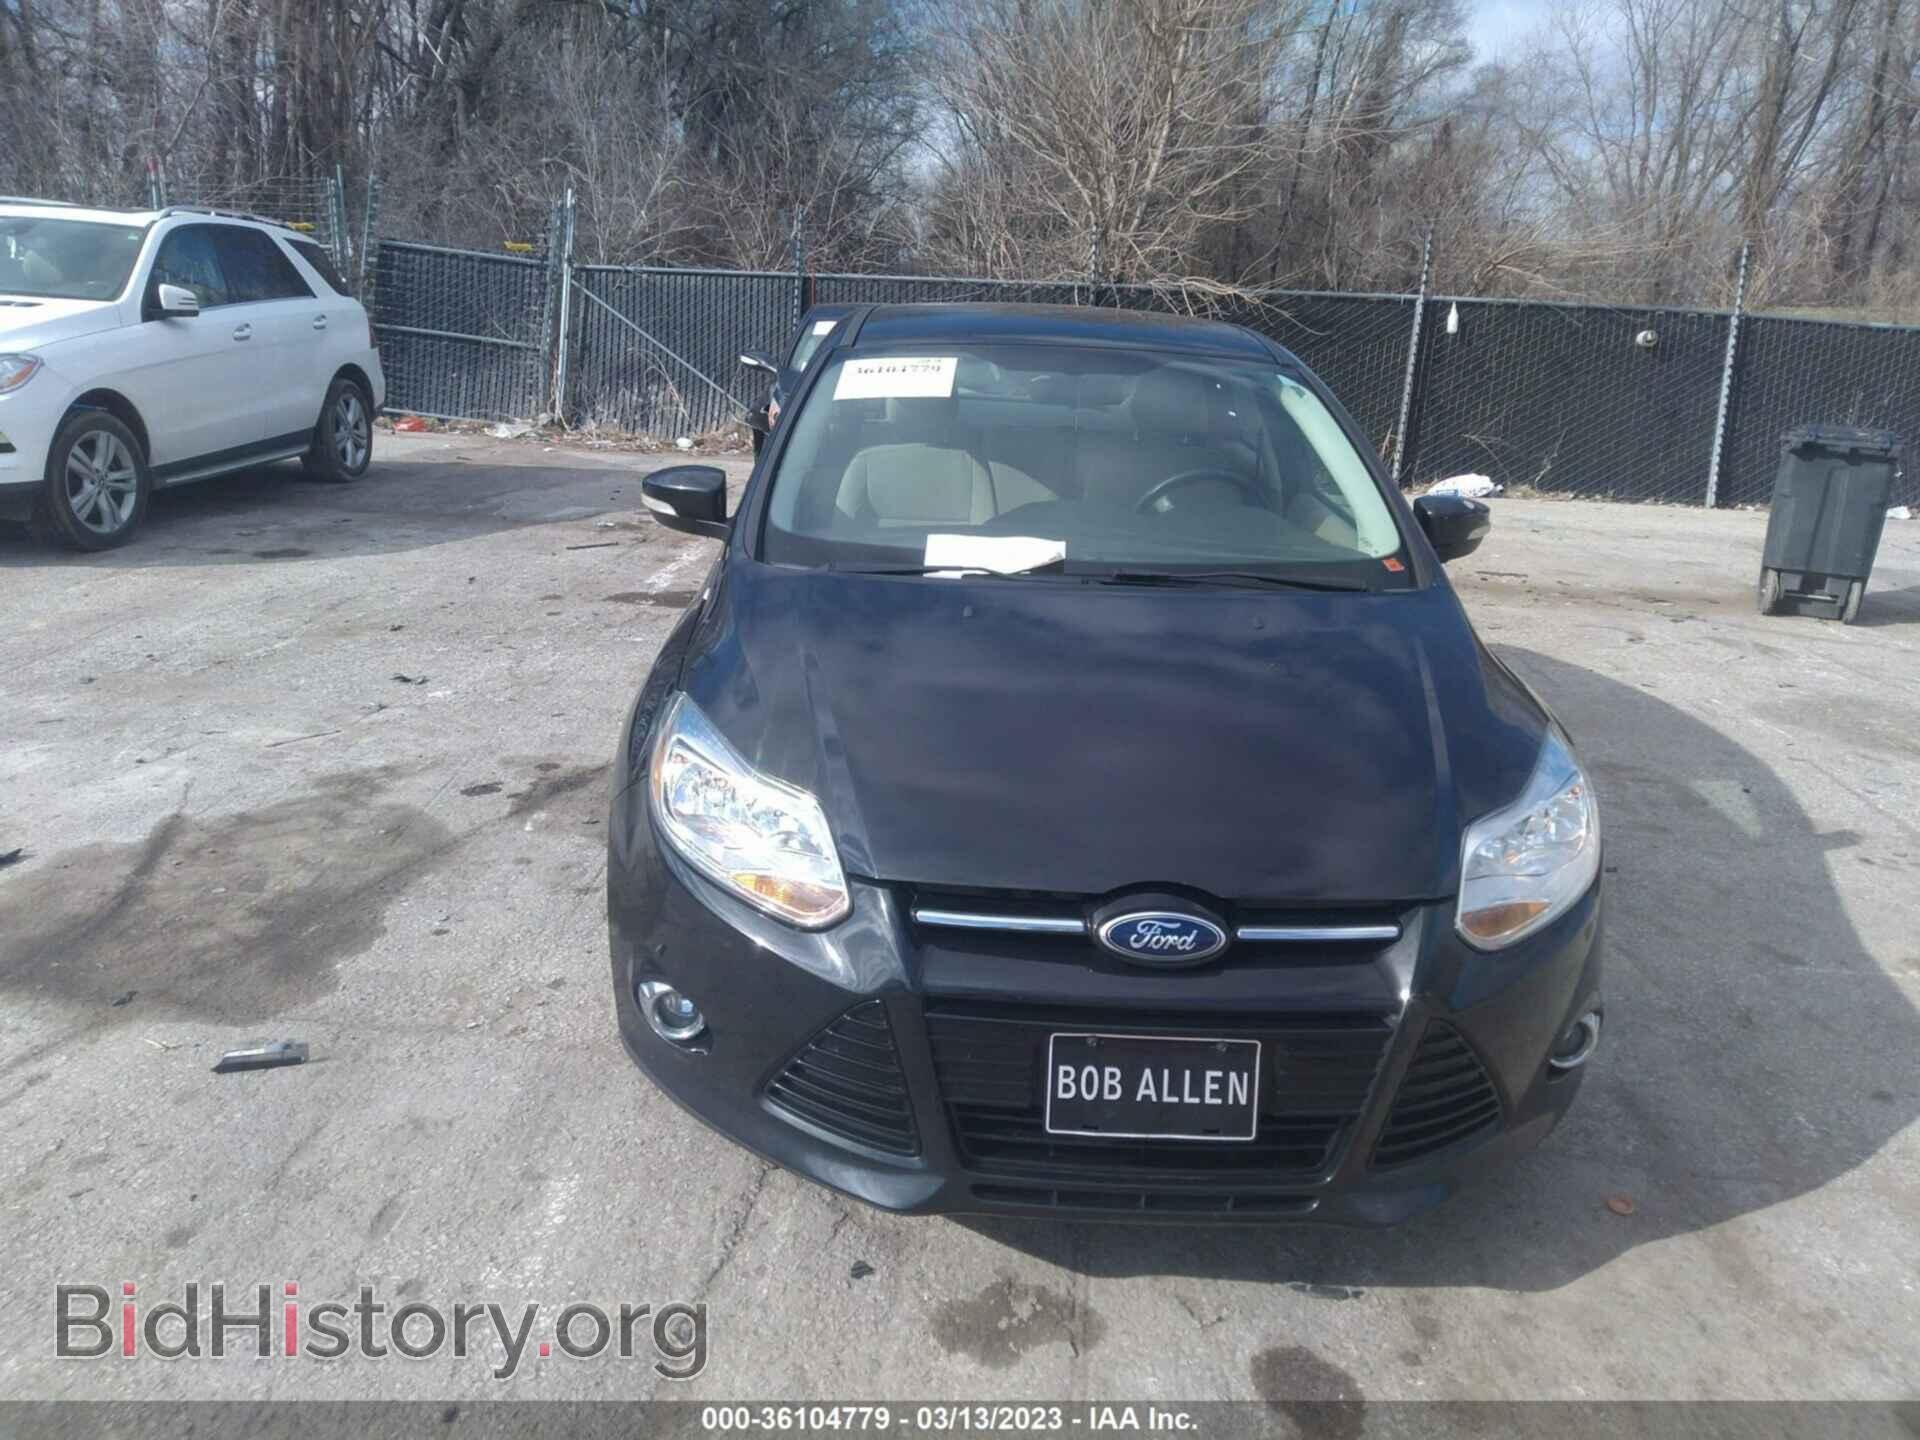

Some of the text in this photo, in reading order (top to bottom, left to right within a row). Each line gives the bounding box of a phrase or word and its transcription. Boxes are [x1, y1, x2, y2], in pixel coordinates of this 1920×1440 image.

[1130, 919, 1198, 950] Ford
[1057, 1065, 1249, 1105] BOB ALLEN
